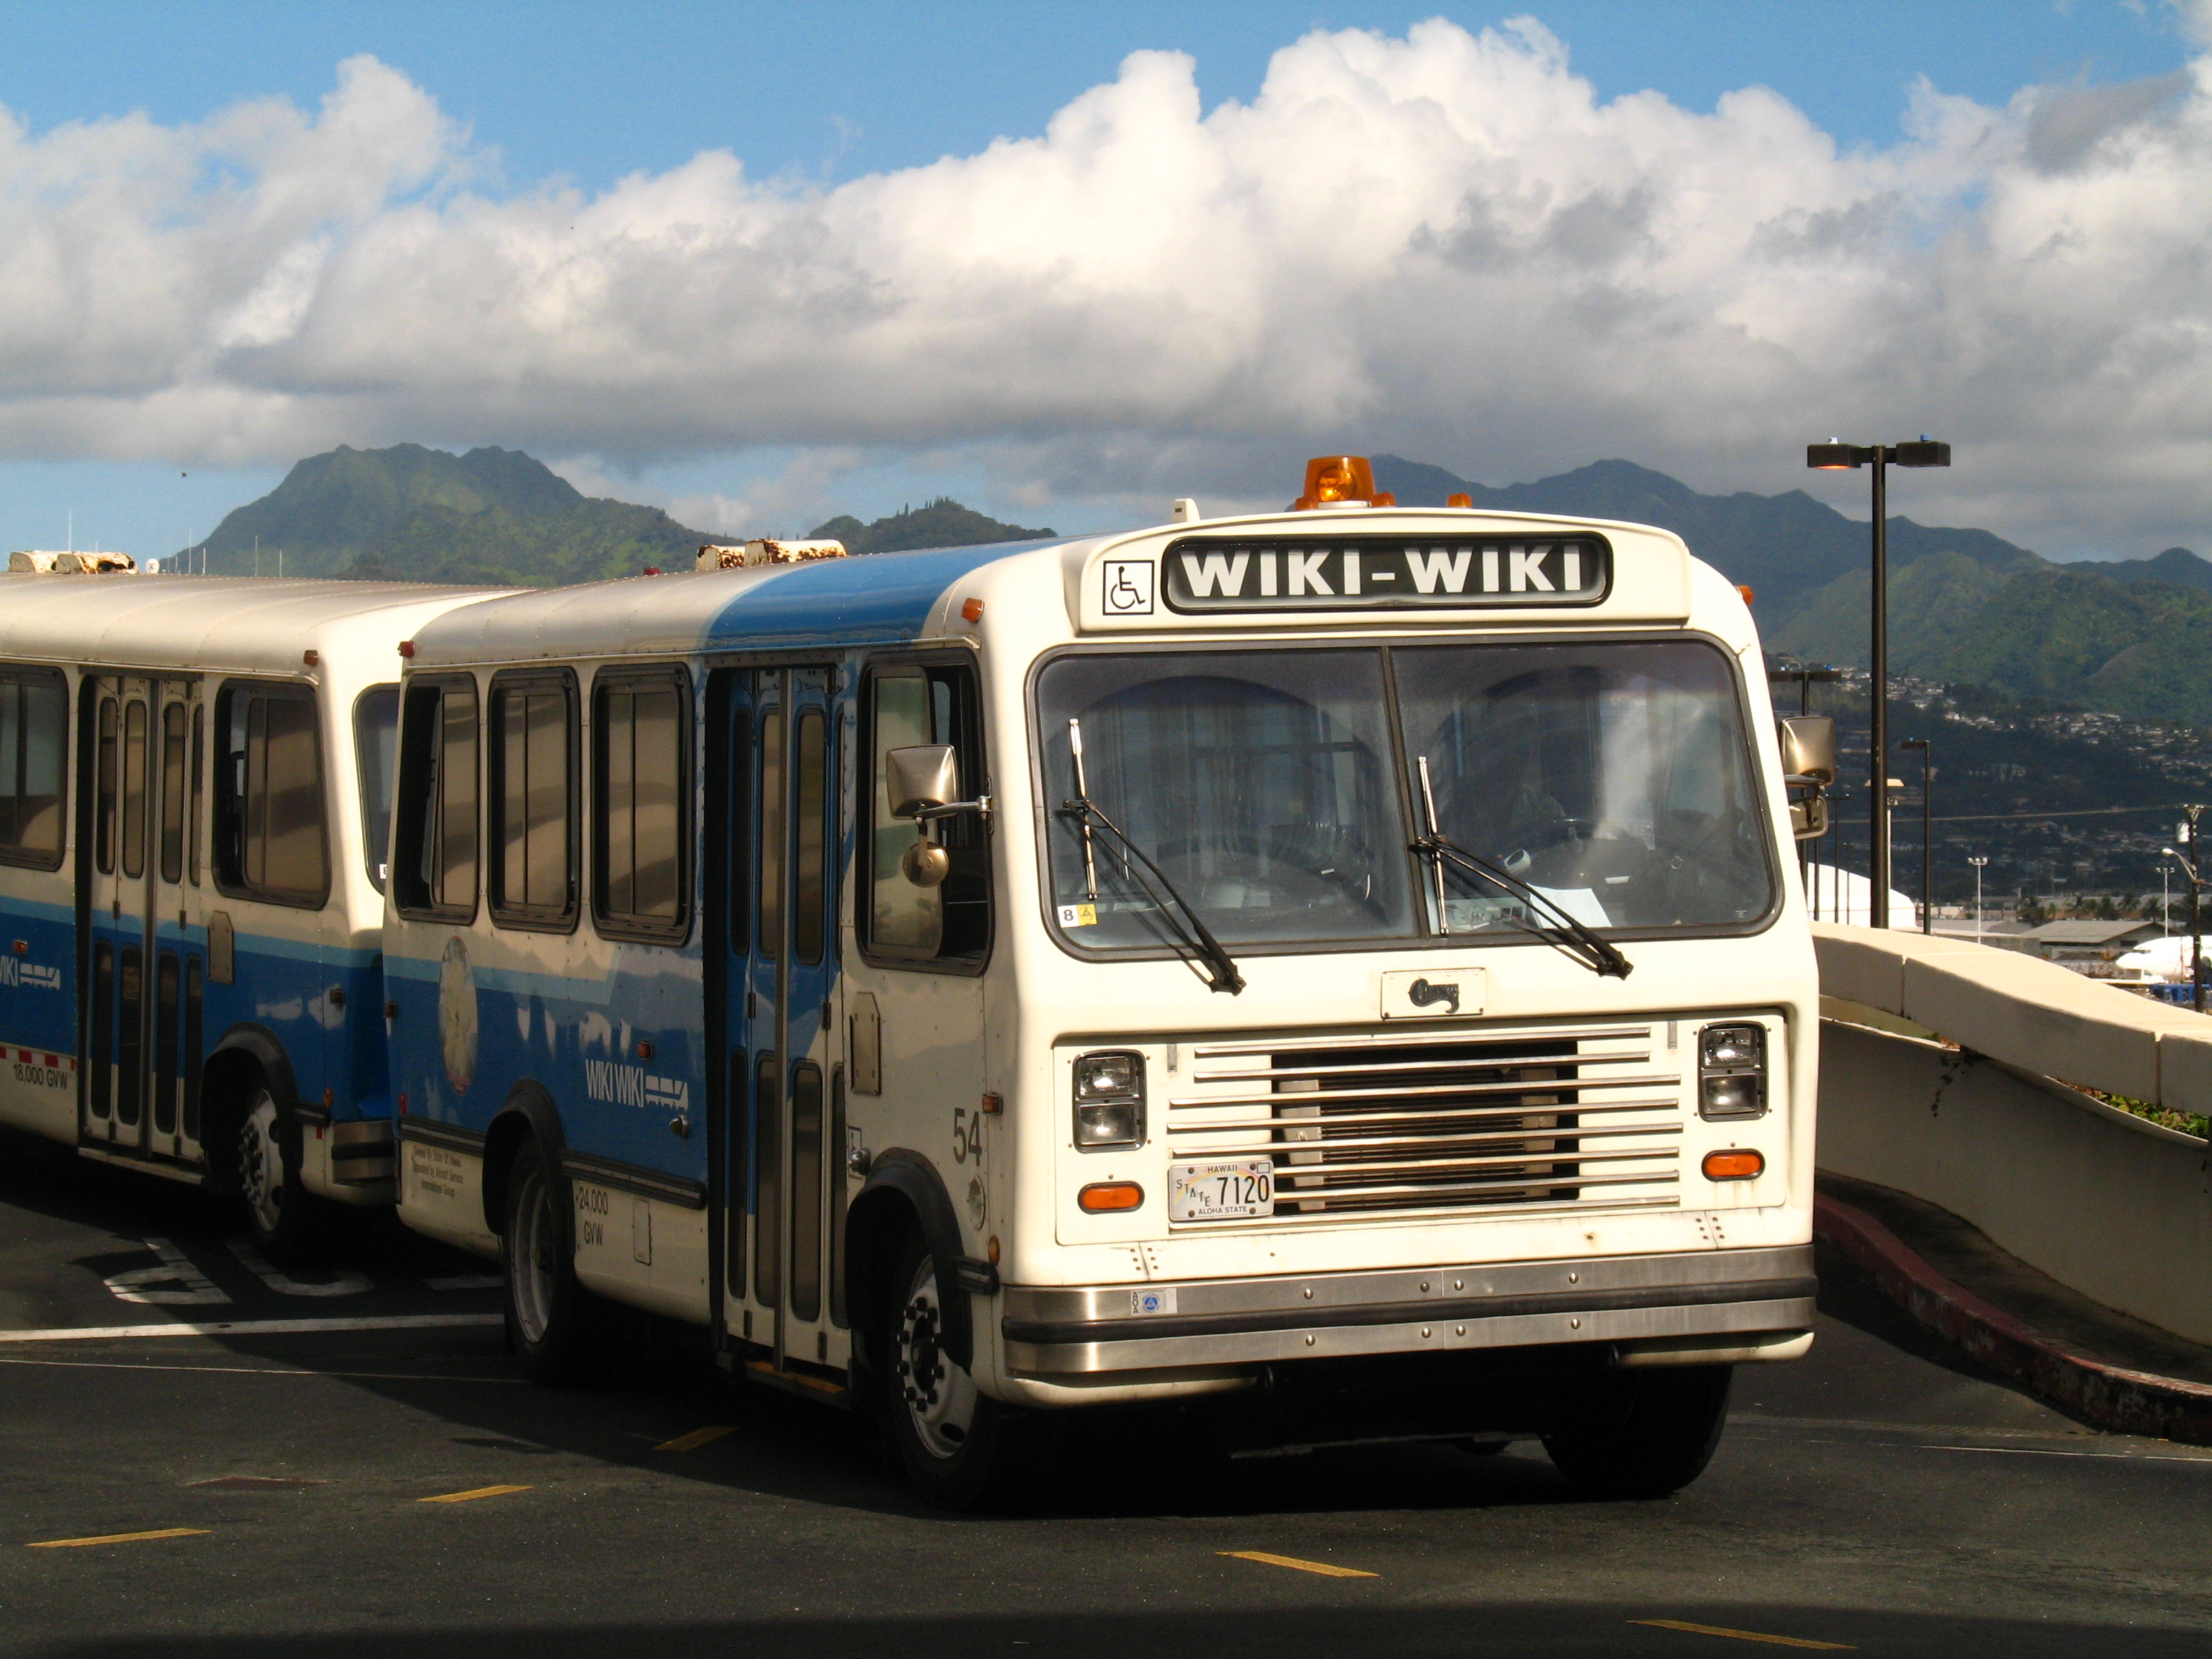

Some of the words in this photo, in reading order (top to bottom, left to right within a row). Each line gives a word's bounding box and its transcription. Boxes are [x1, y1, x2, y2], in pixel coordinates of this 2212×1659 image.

[1179, 545, 1581, 597] WIKI-WIKI
[1064, 909, 1074, 921] 8
[0, 955, 19, 987] IKI
[14, 1064, 44, 1085] 18,000
[47, 1069, 68, 1089] GVW
[585, 1058, 613, 1102] WIKI
[614, 1064, 644, 1108] WIKI
[953, 1107, 983, 1166] 54
[1208, 1165, 1238, 1174] HAWAII
[580, 1186, 608, 1215] 24,000
[1217, 1175, 1269, 1205] 7120
[584, 1220, 603, 1246] GVW
